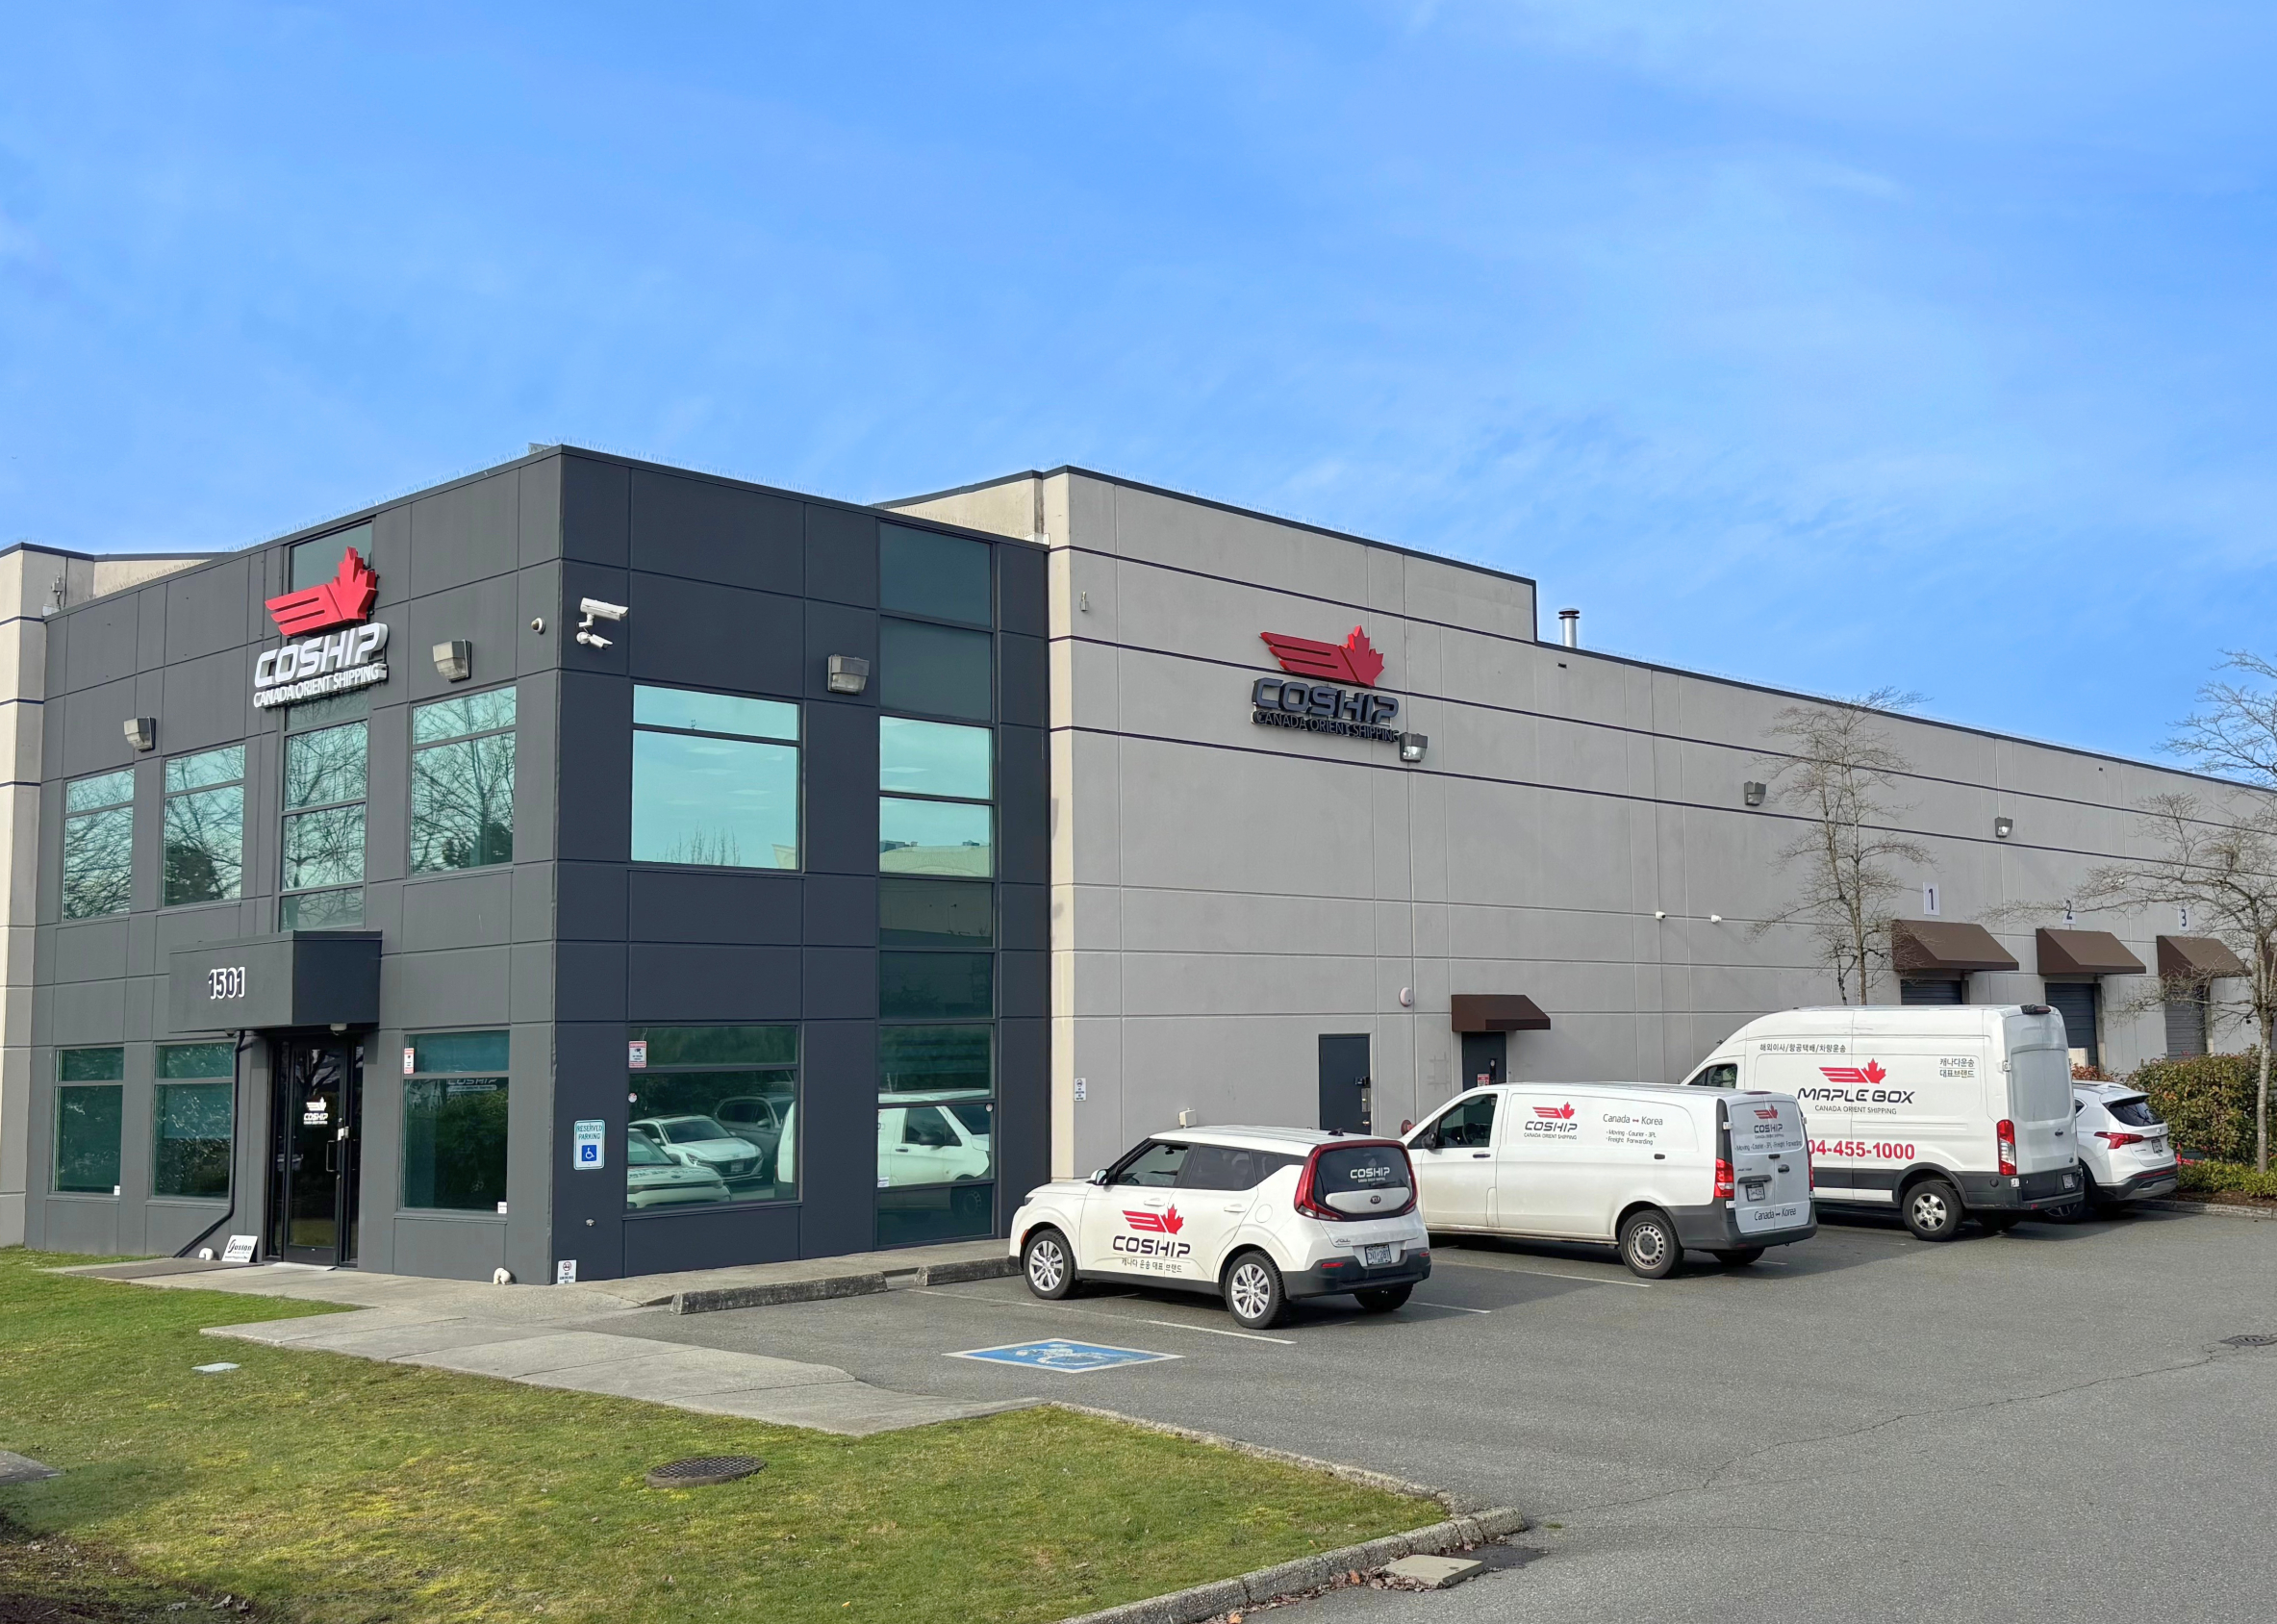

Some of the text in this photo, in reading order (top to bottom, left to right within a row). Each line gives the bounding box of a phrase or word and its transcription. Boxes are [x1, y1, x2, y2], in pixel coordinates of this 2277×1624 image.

[255, 622, 389, 688] COSHIP
[253, 663, 386, 708] CANADA ORIENT SHIPPING
[1252, 677, 1400, 723] COSHIP
[1253, 711, 1401, 744] CANADA ORIENT SHIPPING
[1928, 887, 1935, 910] 1
[2065, 900, 2073, 920] 2
[2181, 909, 2188, 927] 3
[208, 966, 245, 1000] 1501
[1939, 1058, 1975, 1067] 캐나다운송
[1939, 1069, 1975, 1078] 대표브랜드
[1797, 1087, 1915, 1104] MAPLE BOX
[1867, 1106, 1897, 1115] SHIPPING
[1525, 1121, 1578, 1132] COSHIP
[1603, 1114, 1663, 1126] Canada Korea
[1754, 1124, 1784, 1133] COSHIP
[1350, 1167, 1390, 1180] COSHIP
[1755, 1207, 1796, 1221] Canada Korea
[1113, 1235, 1191, 1257] COSHIP
[1122, 1257, 1182, 1273] 캐나다 운송 대표 브랜드
